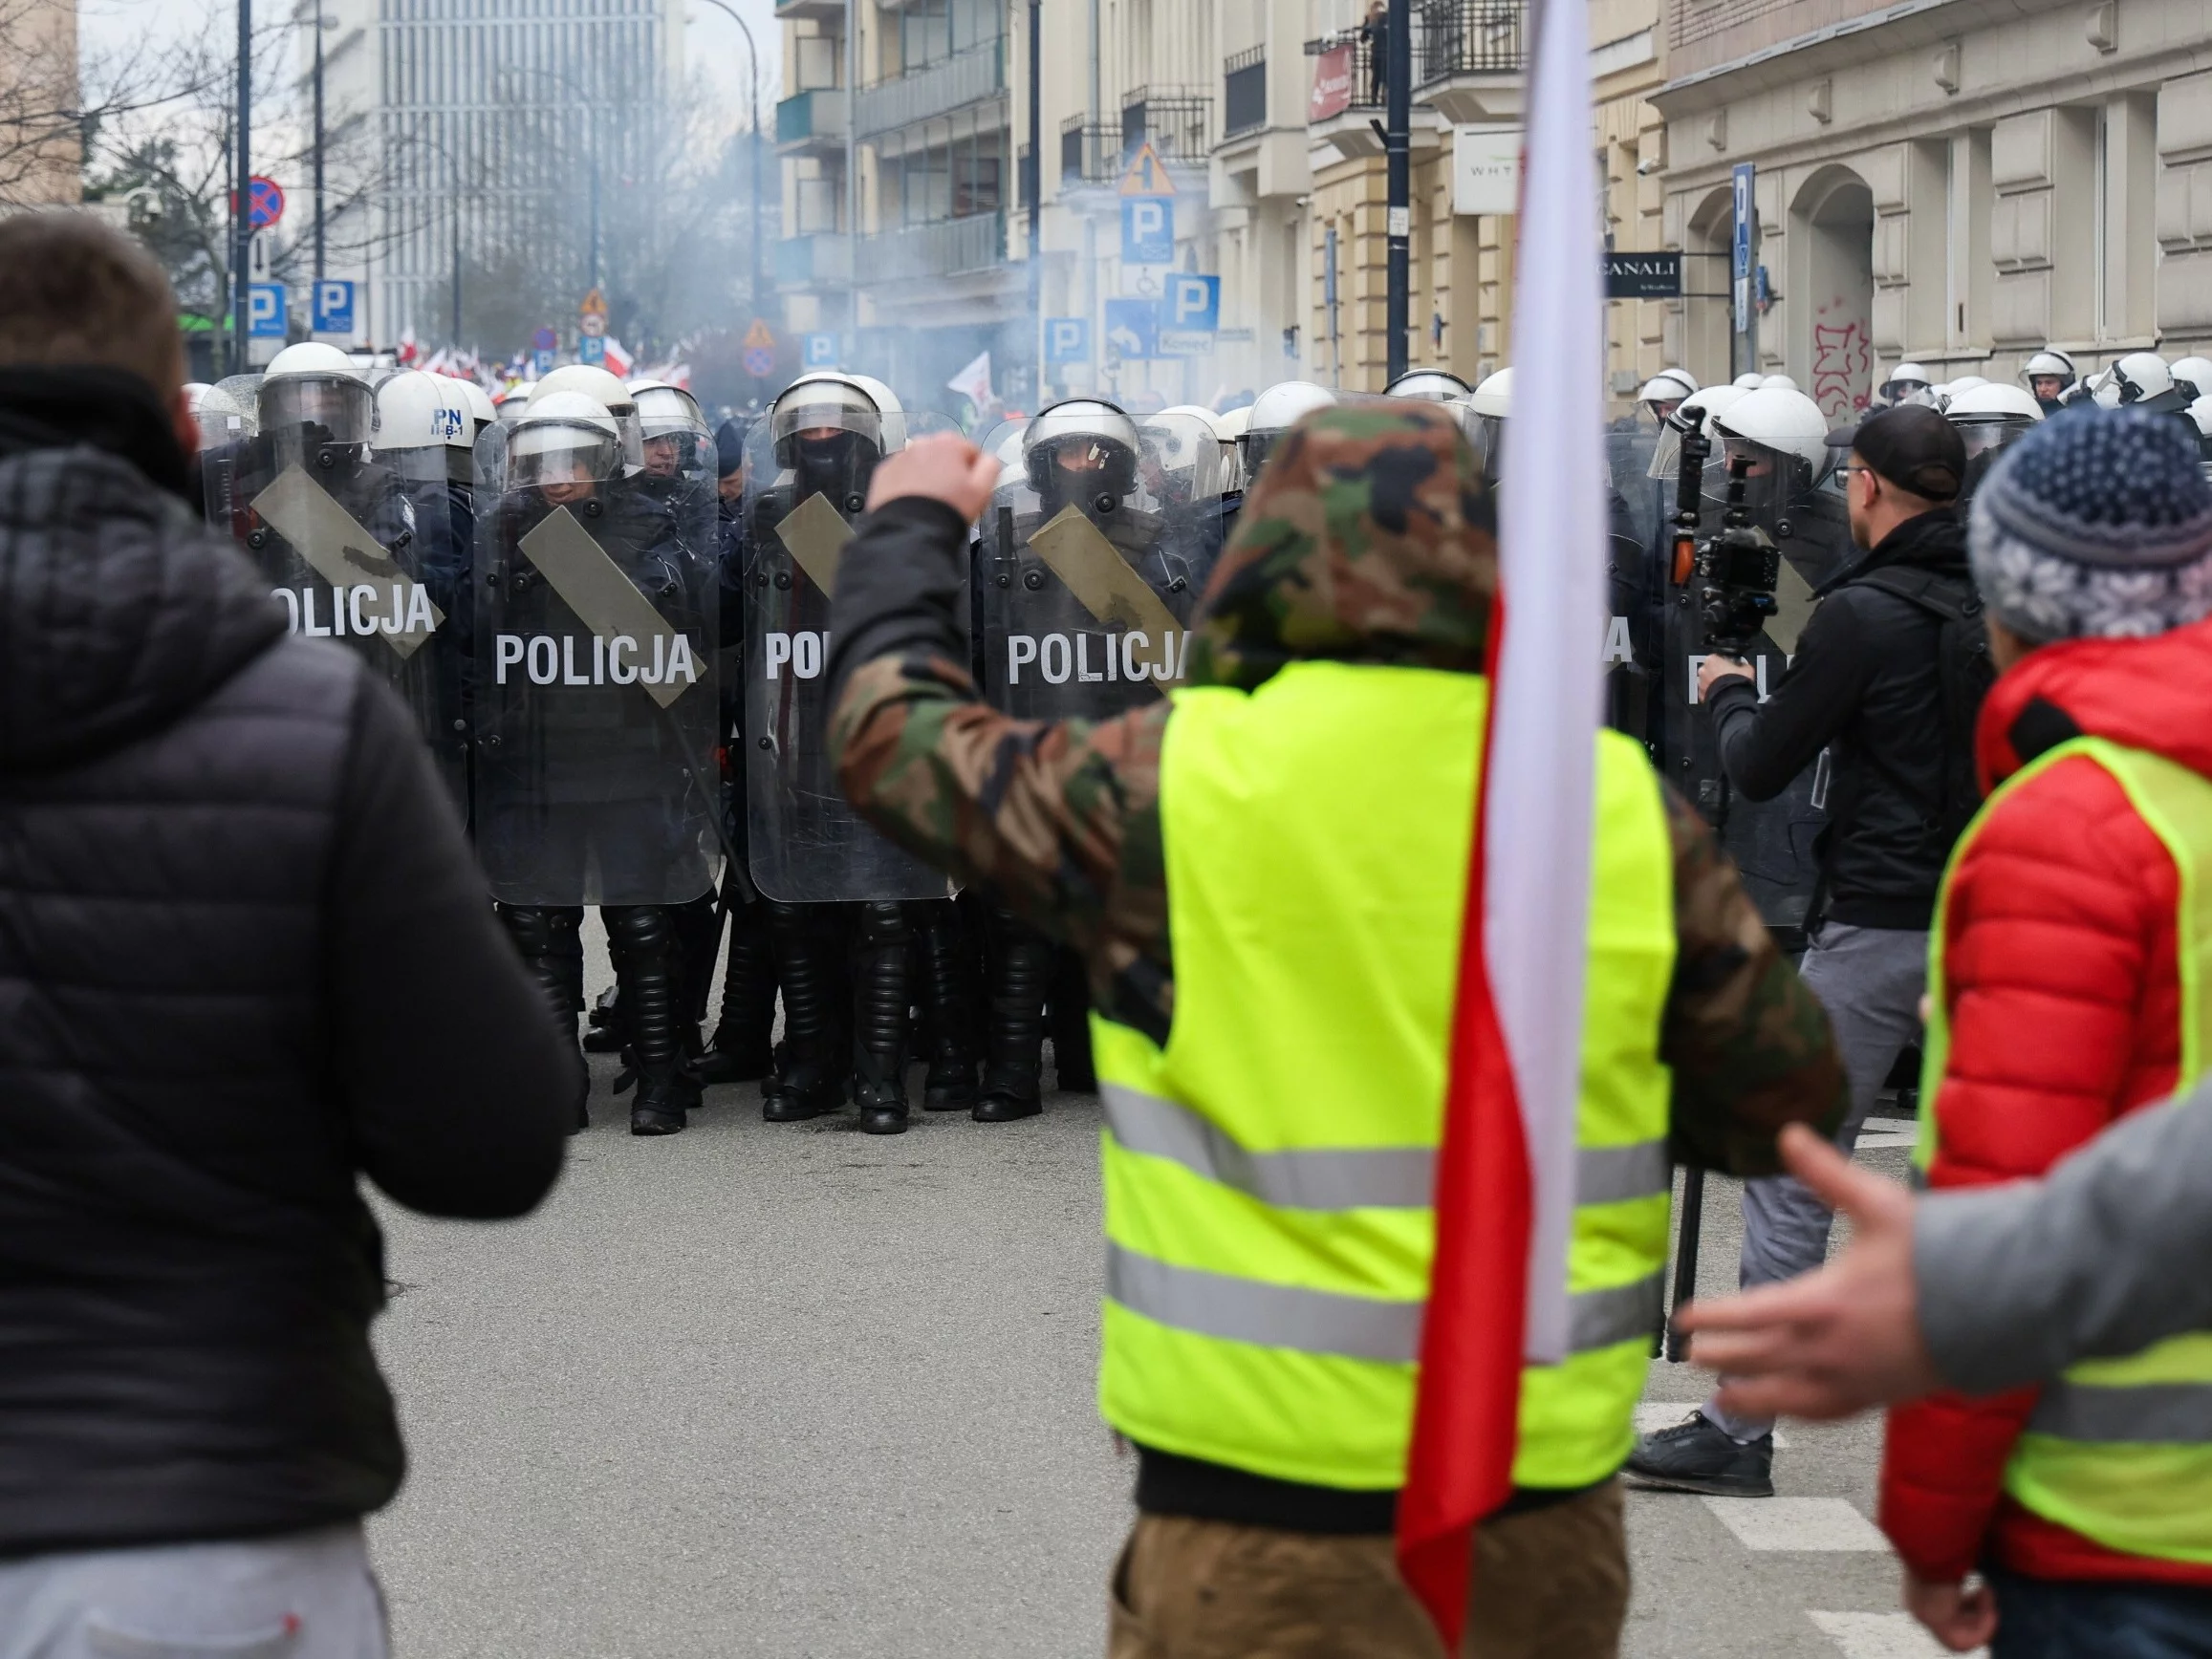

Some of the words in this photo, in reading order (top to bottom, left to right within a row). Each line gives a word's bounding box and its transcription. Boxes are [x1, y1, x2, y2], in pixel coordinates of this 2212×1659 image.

[1133, 203, 1163, 244] P
[1736, 174, 1747, 244] P
[1596, 261, 1675, 275] CANALI
[249, 289, 276, 331] P
[319, 284, 347, 317] P
[1176, 279, 1209, 323] P
[586, 338, 601, 358] P
[812, 336, 832, 362] P
[1053, 322, 1080, 356] P
[538, 352, 553, 370] P
[434, 409, 462, 425] PN
[270, 583, 436, 636] OLICJA
[496, 634, 697, 685] POLICJA
